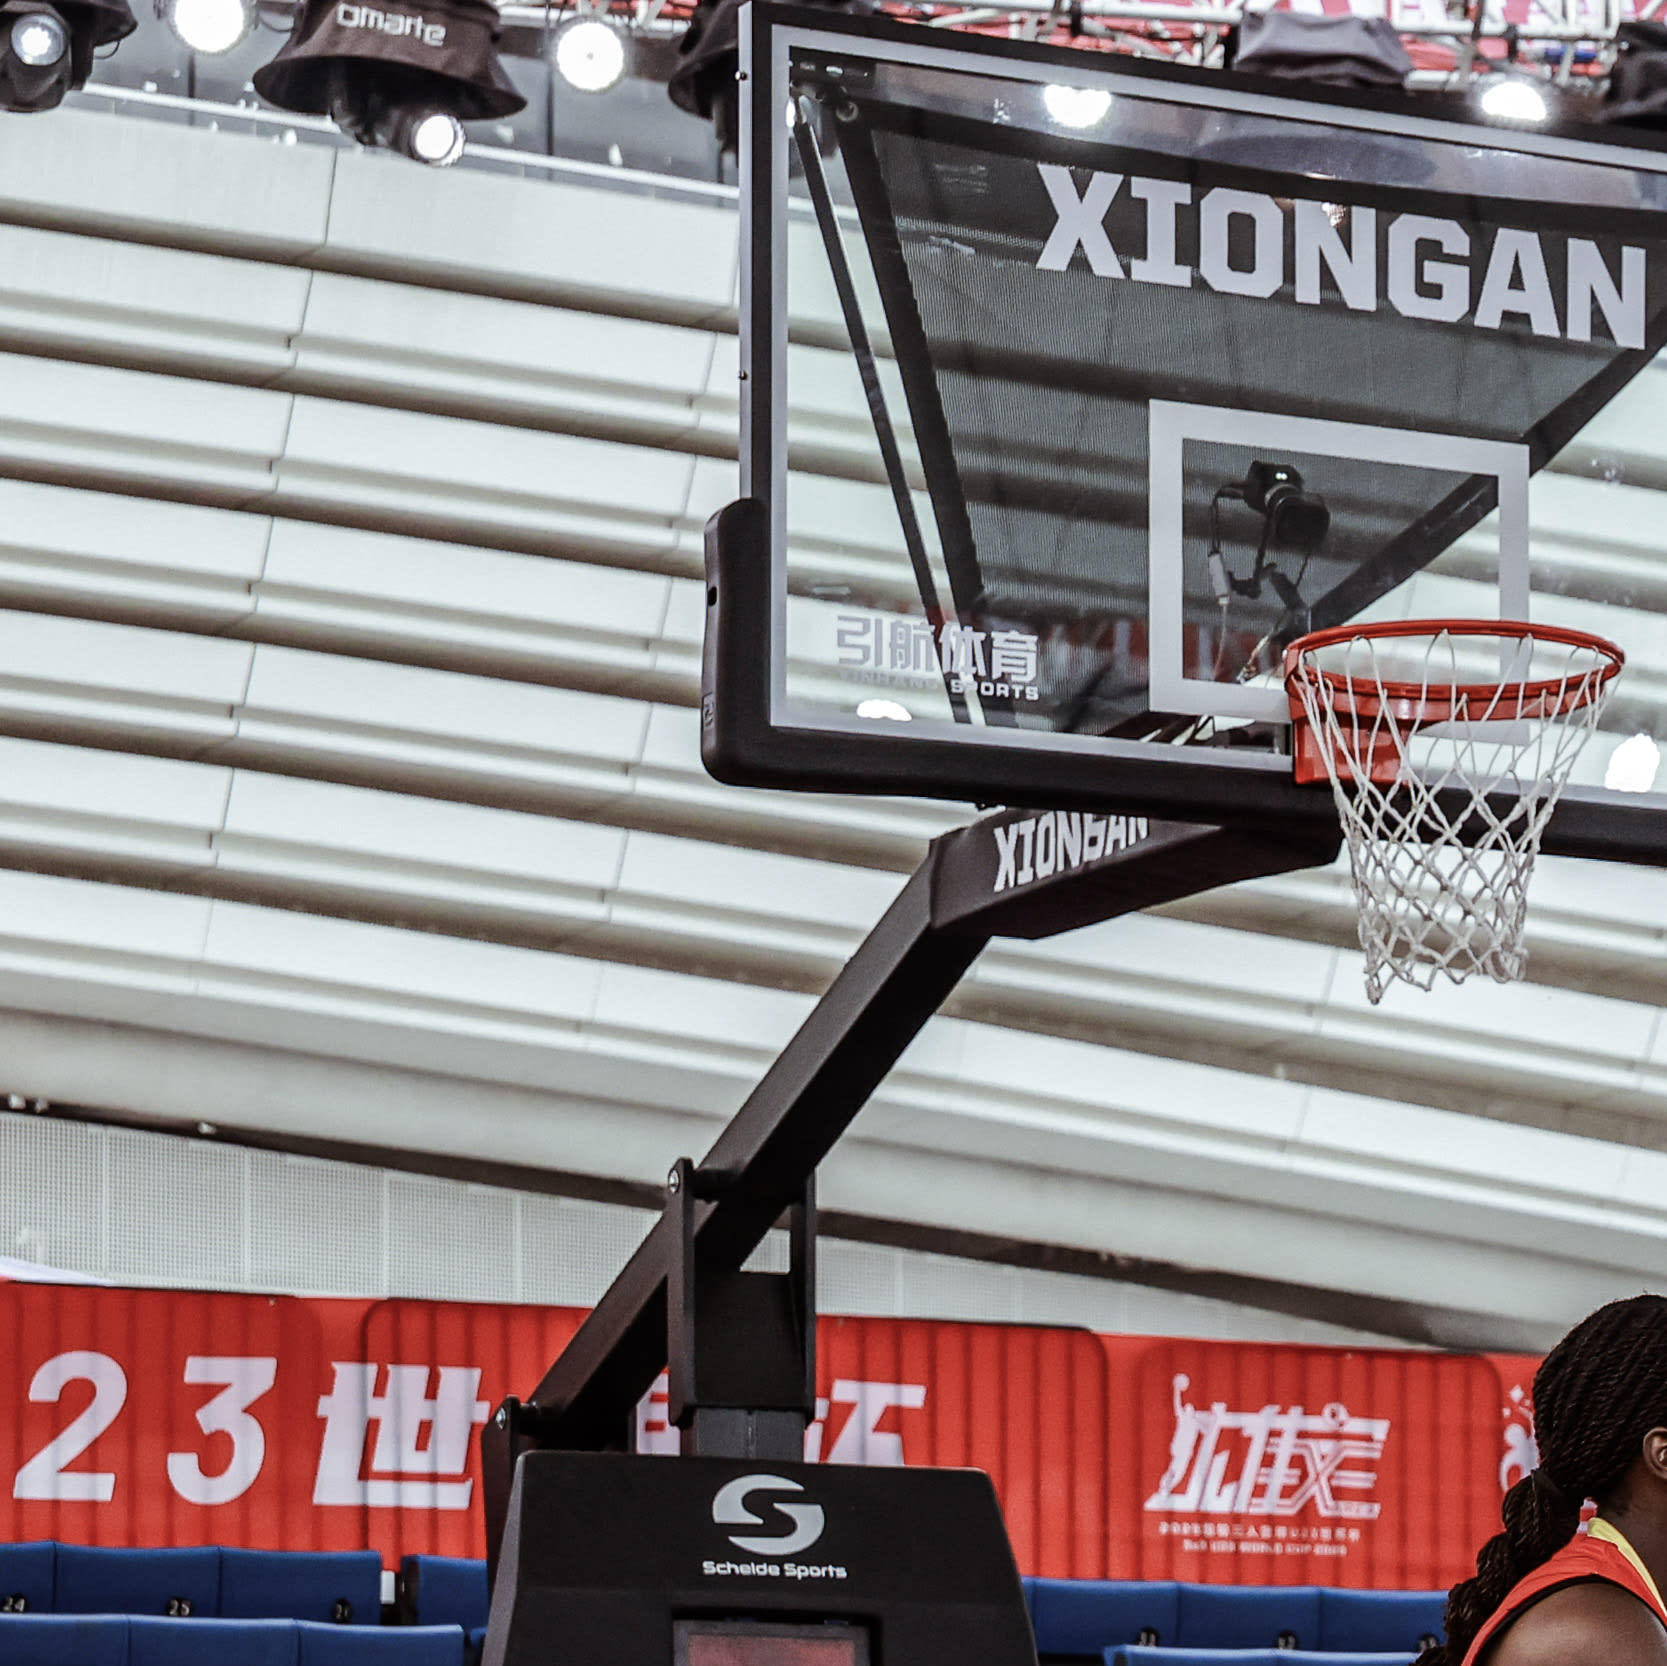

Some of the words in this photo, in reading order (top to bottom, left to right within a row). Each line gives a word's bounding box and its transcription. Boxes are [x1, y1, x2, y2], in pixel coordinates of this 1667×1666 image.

[1036, 163, 1646, 350] XIONGAN
[837, 615, 1038, 683] 引航体育
[951, 677, 1039, 700] SPORTS
[702, 1560, 780, 1576] Schelde
[783, 1562, 848, 1580] Sports
